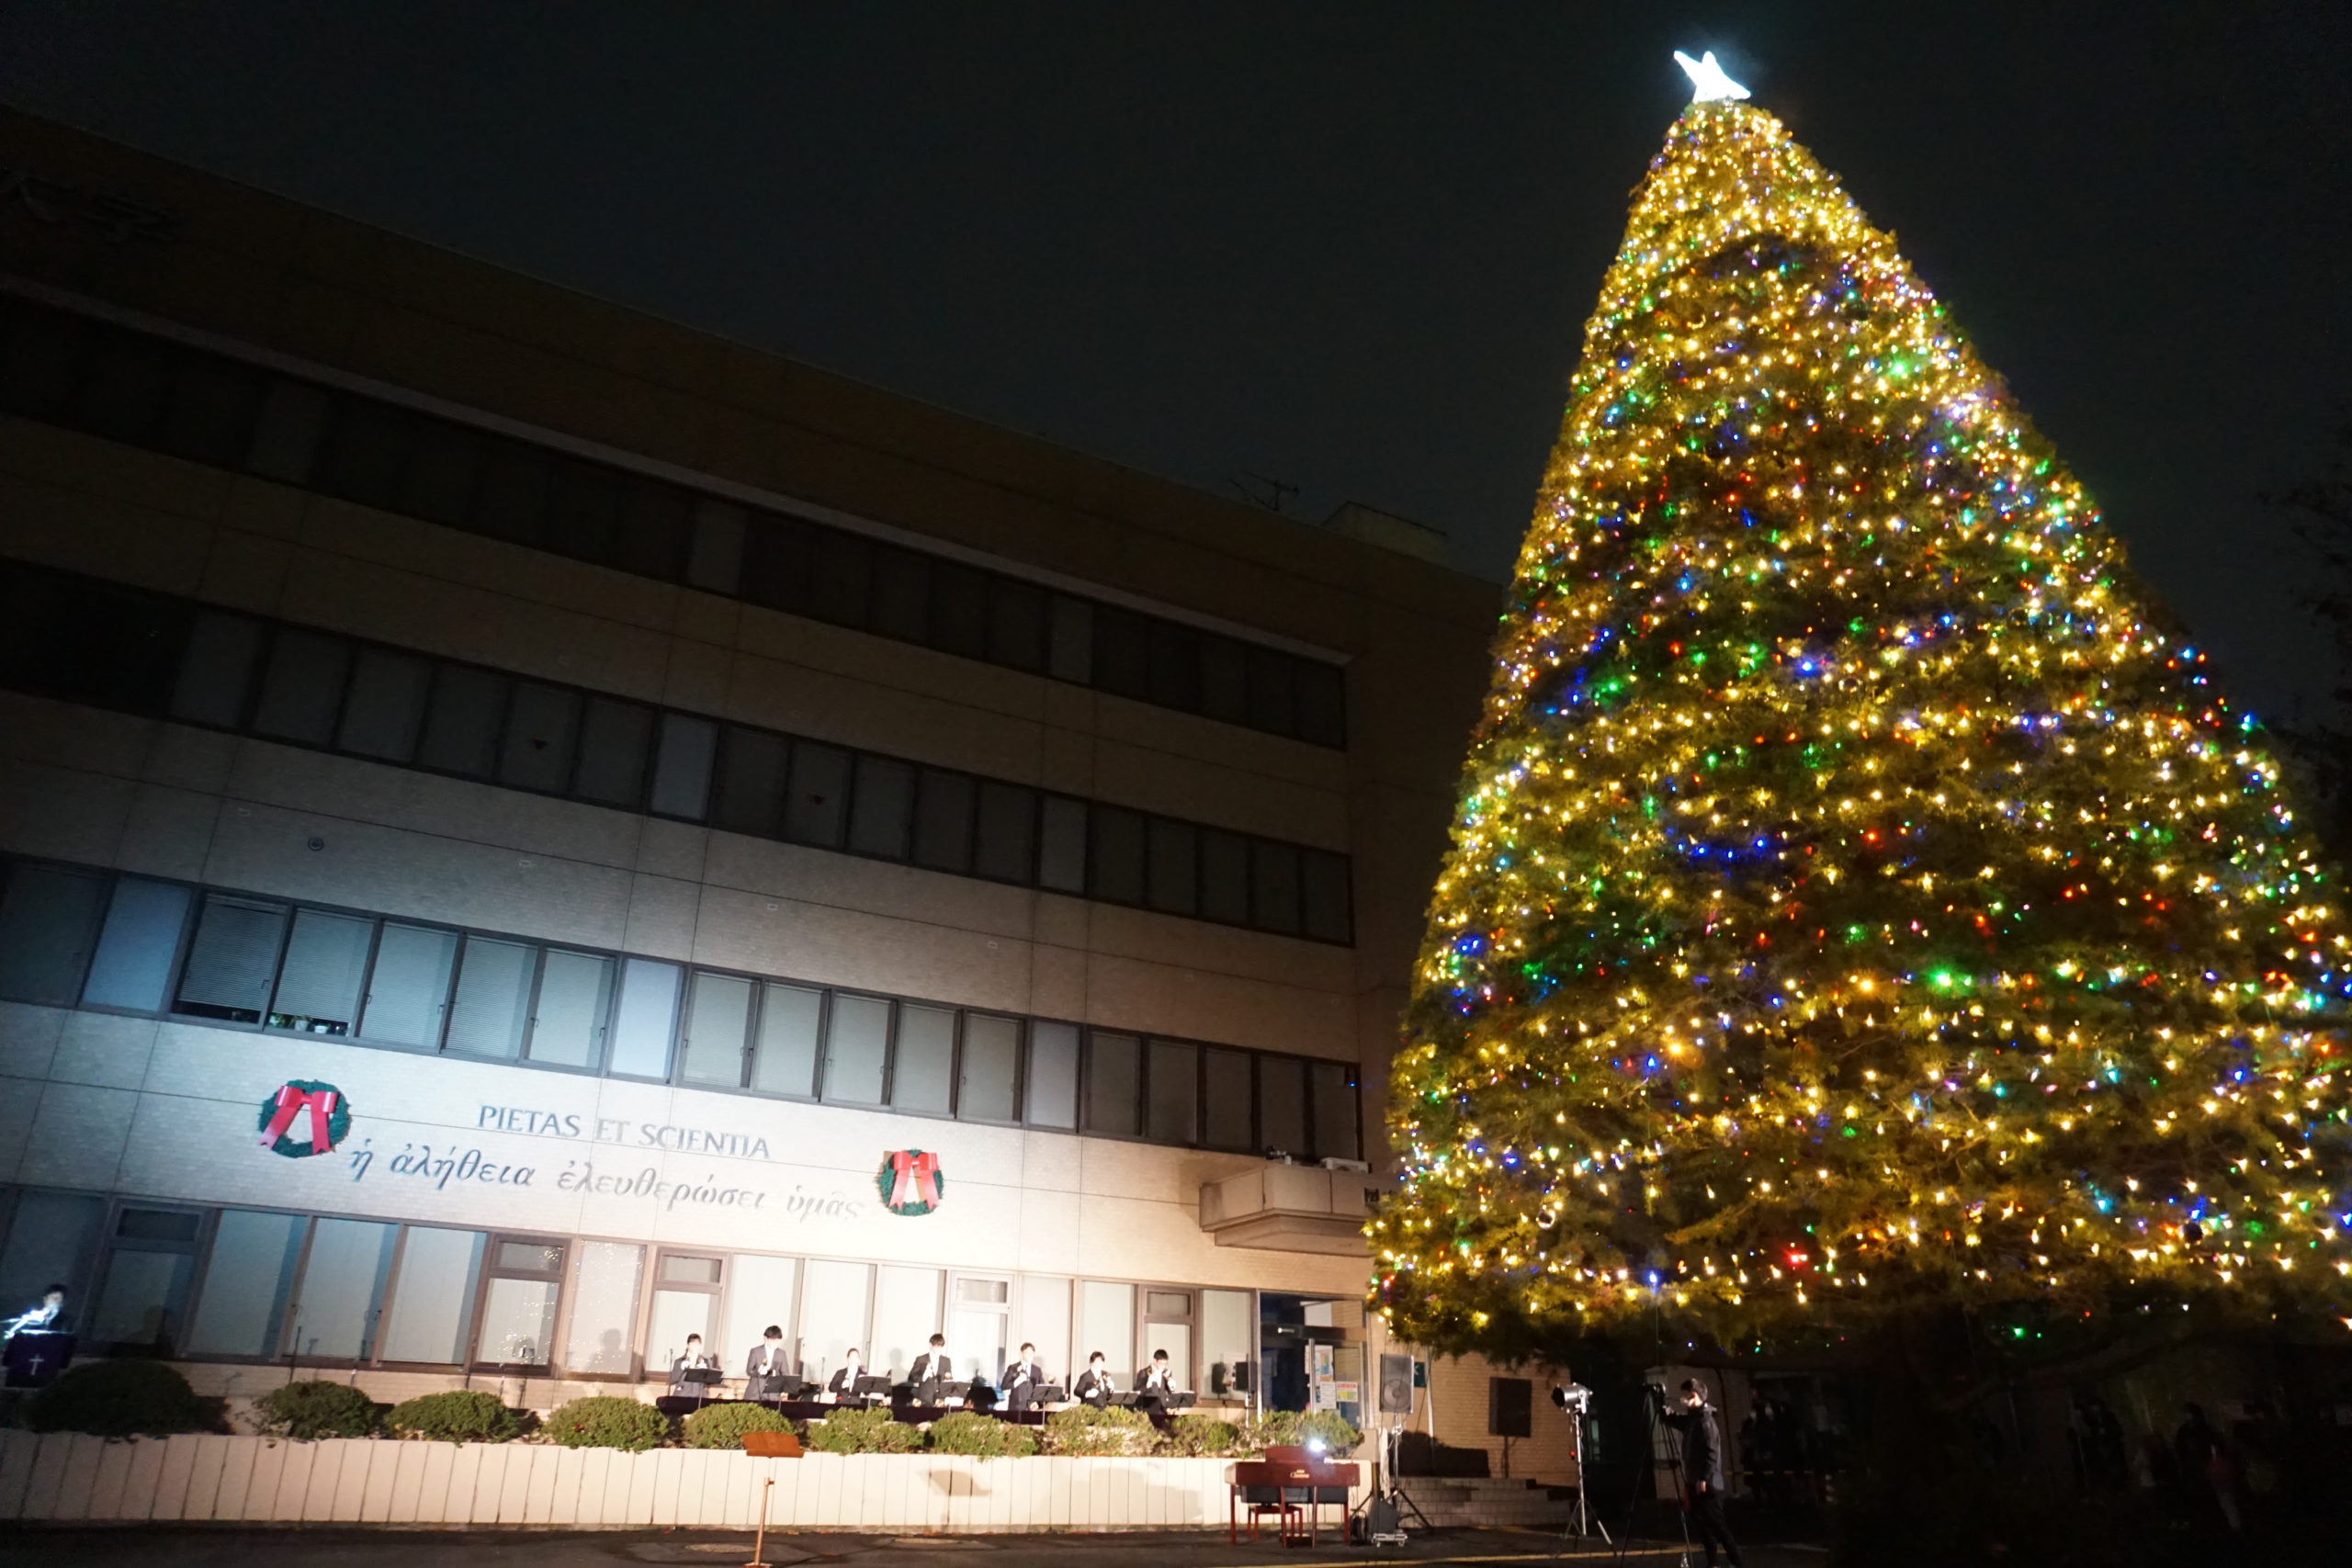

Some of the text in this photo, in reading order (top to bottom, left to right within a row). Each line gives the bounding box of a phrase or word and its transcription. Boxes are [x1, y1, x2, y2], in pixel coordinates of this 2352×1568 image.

[477, 1105, 772, 1159] PIETAS ET SCIENTIA
